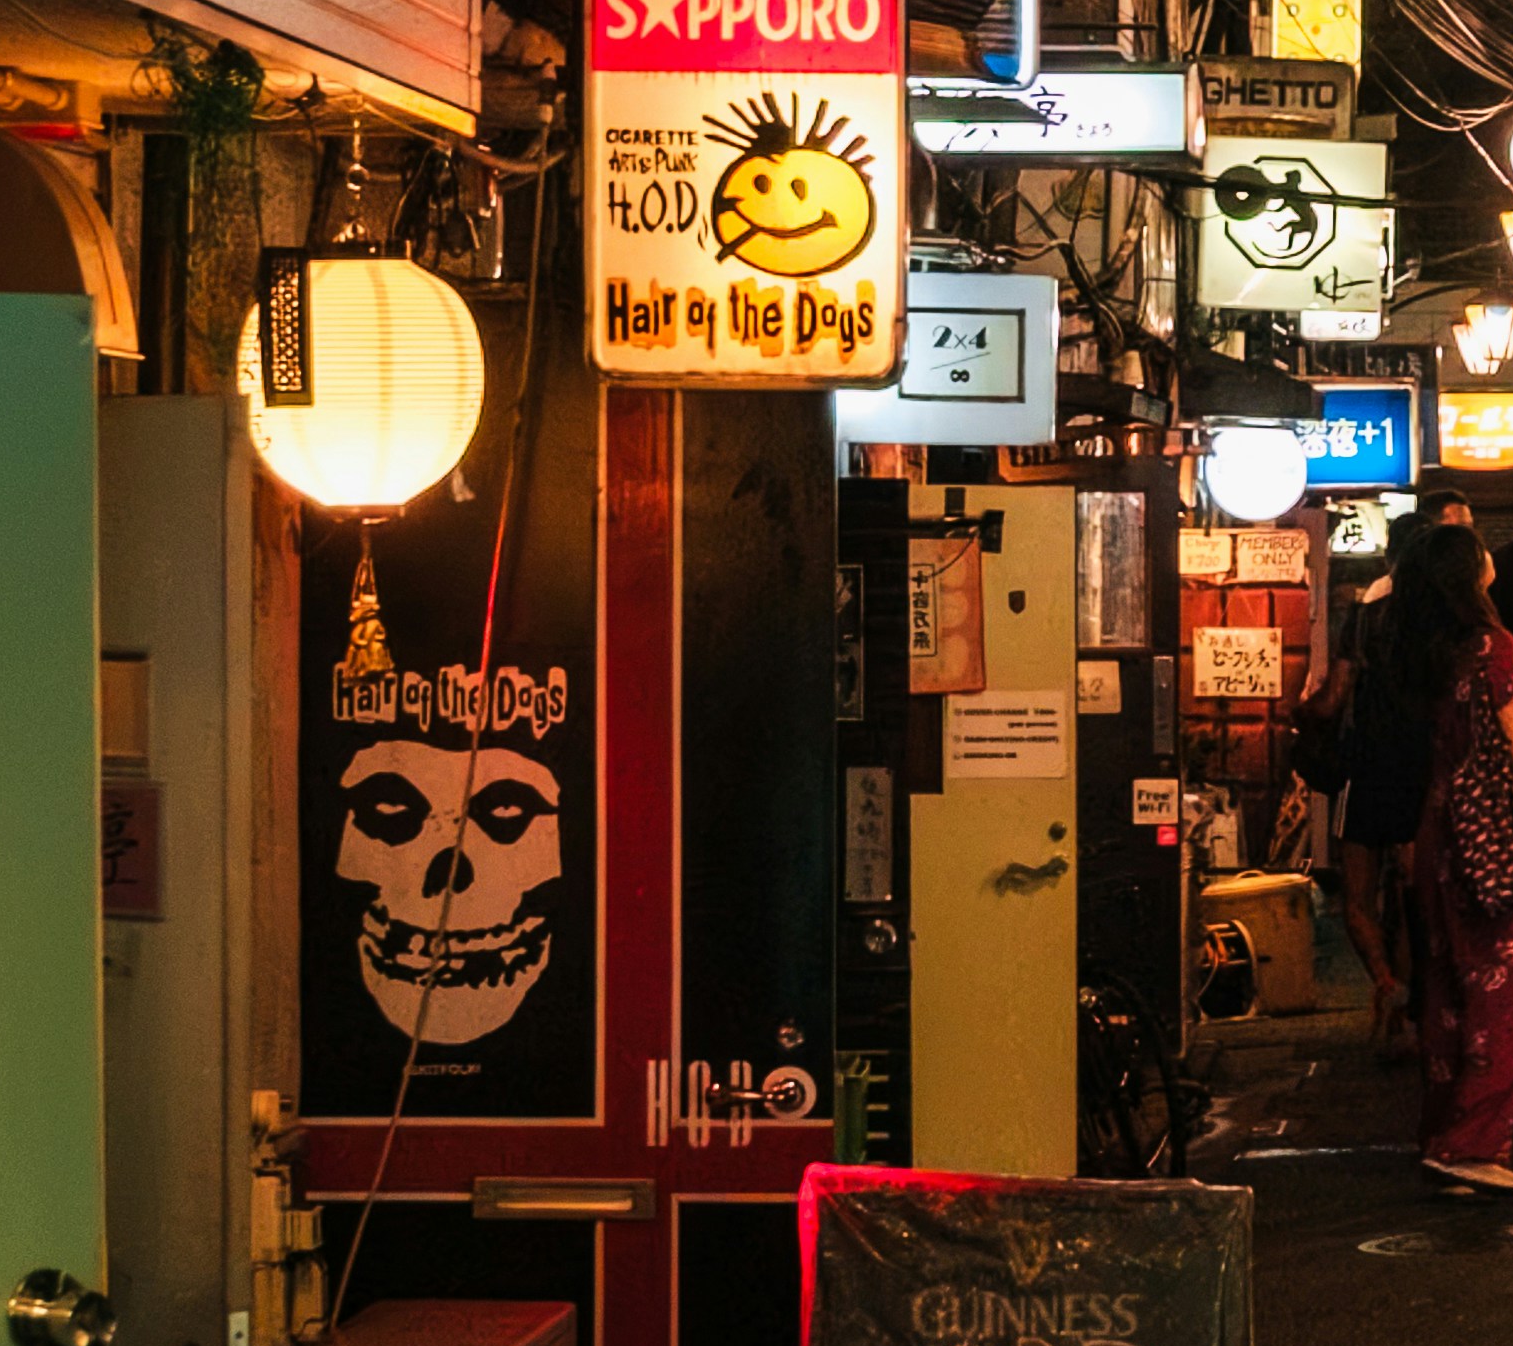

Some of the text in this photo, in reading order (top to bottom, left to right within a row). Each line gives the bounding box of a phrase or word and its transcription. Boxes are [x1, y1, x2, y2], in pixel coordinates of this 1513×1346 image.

[1202, 77, 1336, 111] GHETTO
[608, 282, 874, 353] Hair of the Dogs
[1253, 553, 1293, 565] ONLY
[403, 672, 431, 732] of
[439, 665, 488, 731] the
[492, 667, 566, 740] Dogs
[1137, 790, 1170, 802] Free
[911, 1286, 1141, 1337] GUINNESS
